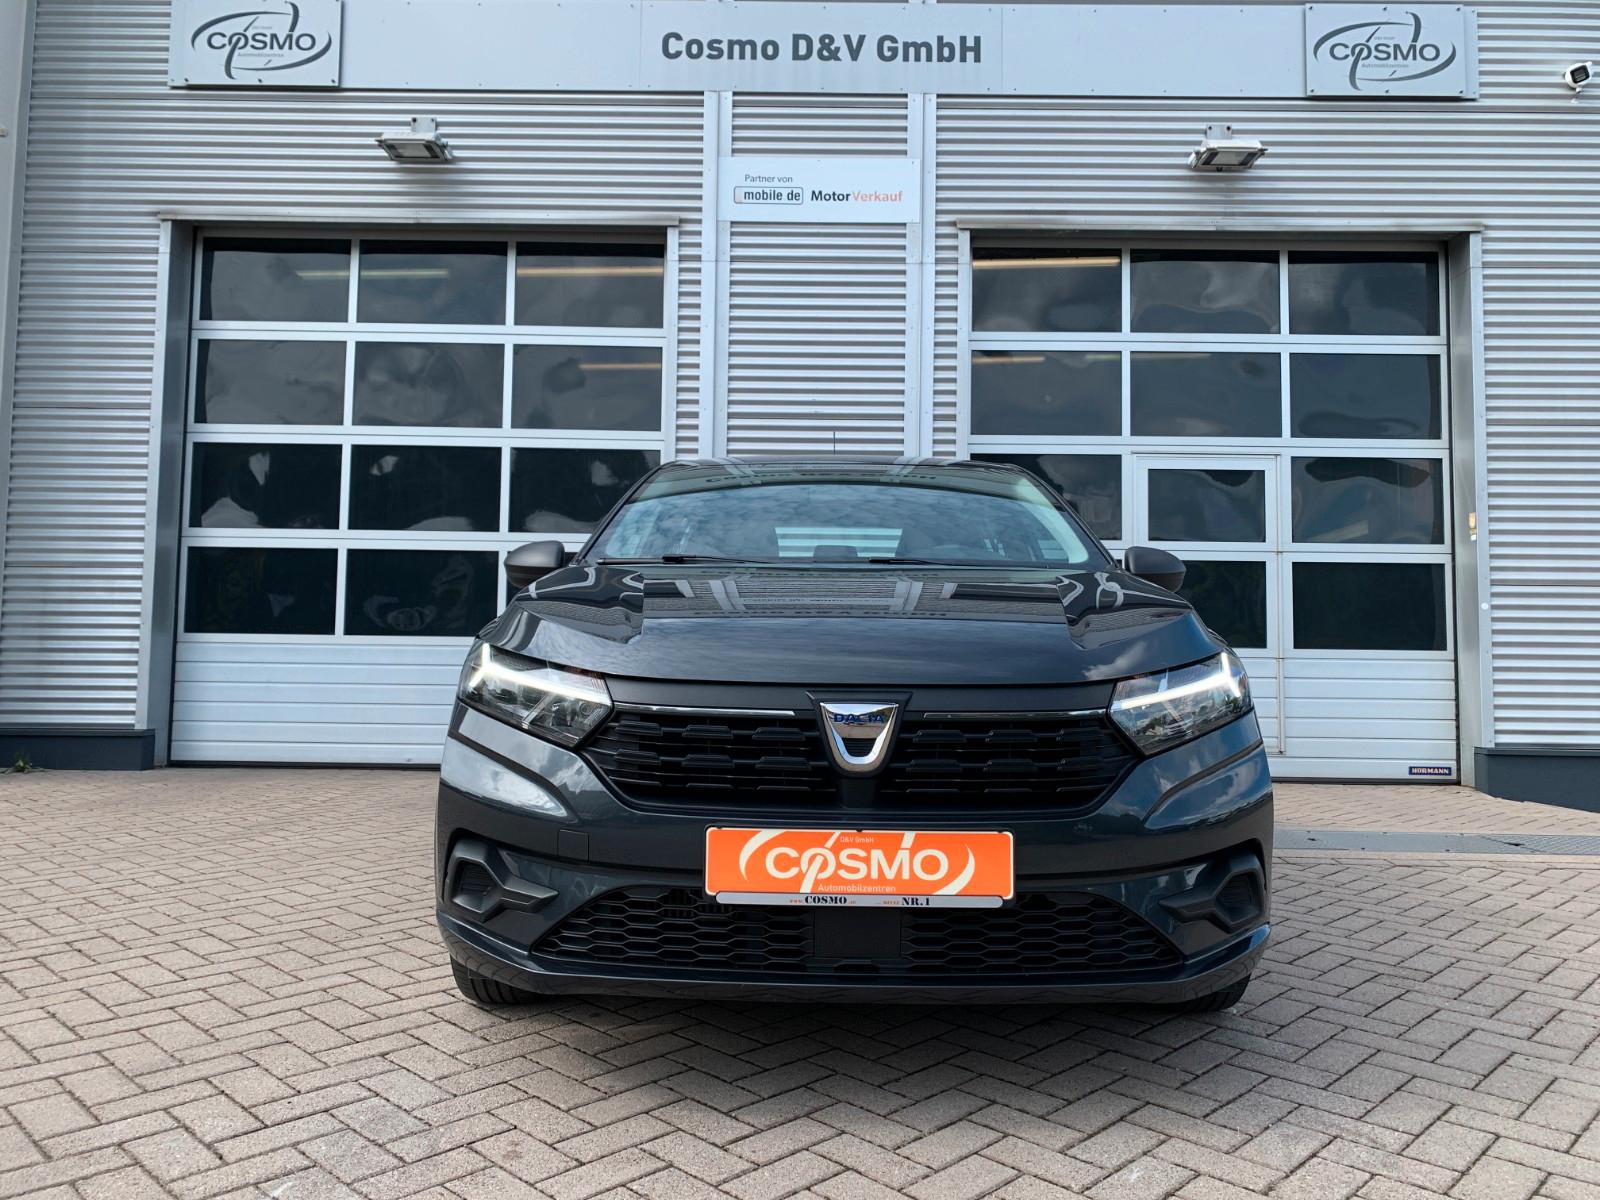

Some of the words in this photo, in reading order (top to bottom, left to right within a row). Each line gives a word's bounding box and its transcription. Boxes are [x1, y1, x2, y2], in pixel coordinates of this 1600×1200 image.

[206, 31, 316, 51] COSMO
[661, 31, 780, 60] Cosmo
[791, 33, 867, 62] D&V
[876, 34, 982, 63] GmbH
[1329, 42, 1441, 61] COSMO
[744, 174, 775, 183] Partner
[765, 847, 949, 881] COSMO
[817, 883, 896, 892] Automobilzentren
